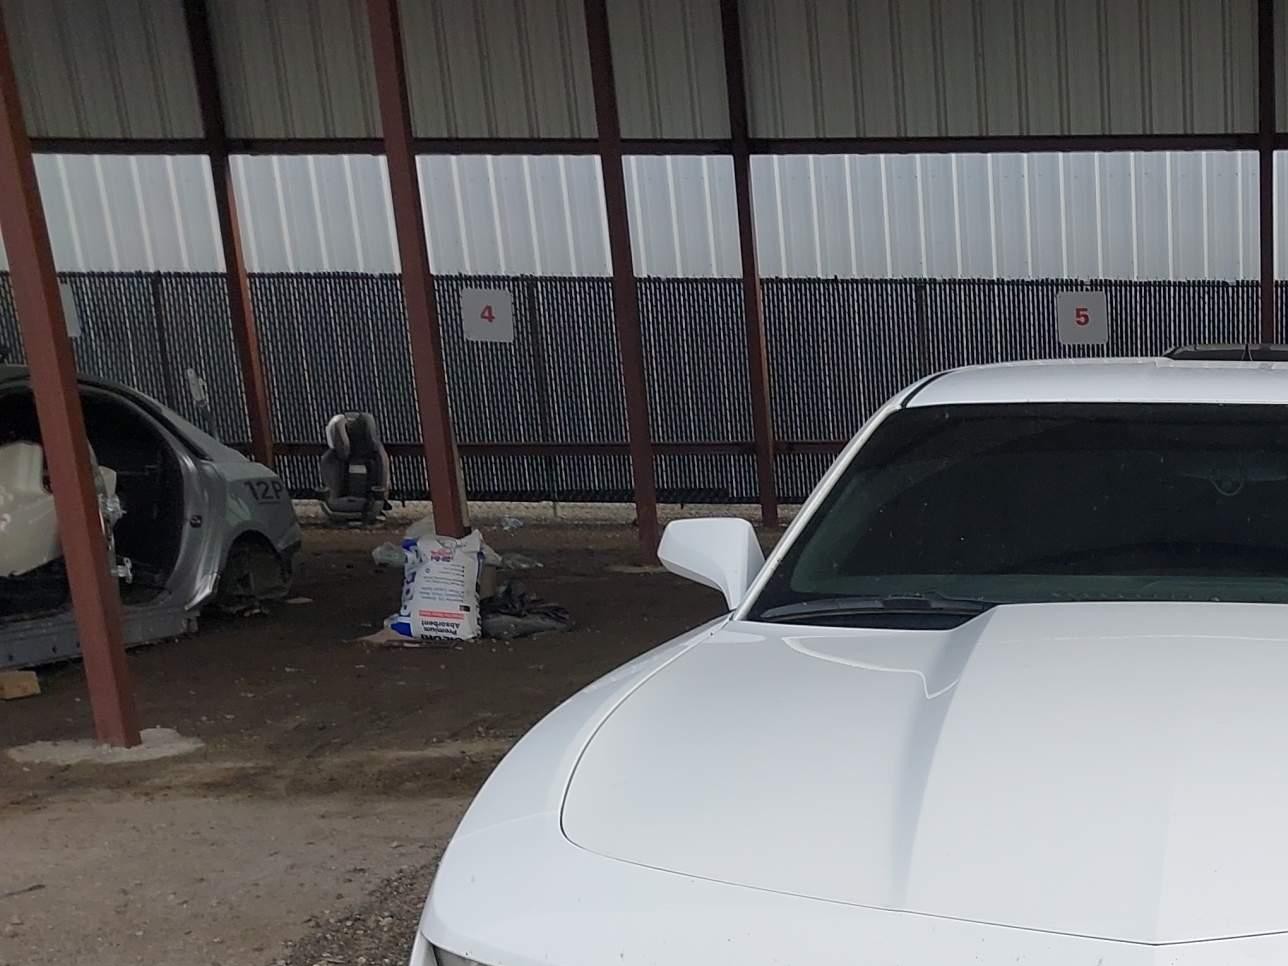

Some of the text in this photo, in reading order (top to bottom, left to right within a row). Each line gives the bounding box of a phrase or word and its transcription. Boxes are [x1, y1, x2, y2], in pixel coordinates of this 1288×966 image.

[479, 305, 496, 323] 4
[1074, 307, 1090, 326] 5
[423, 626, 457, 635] Premium
